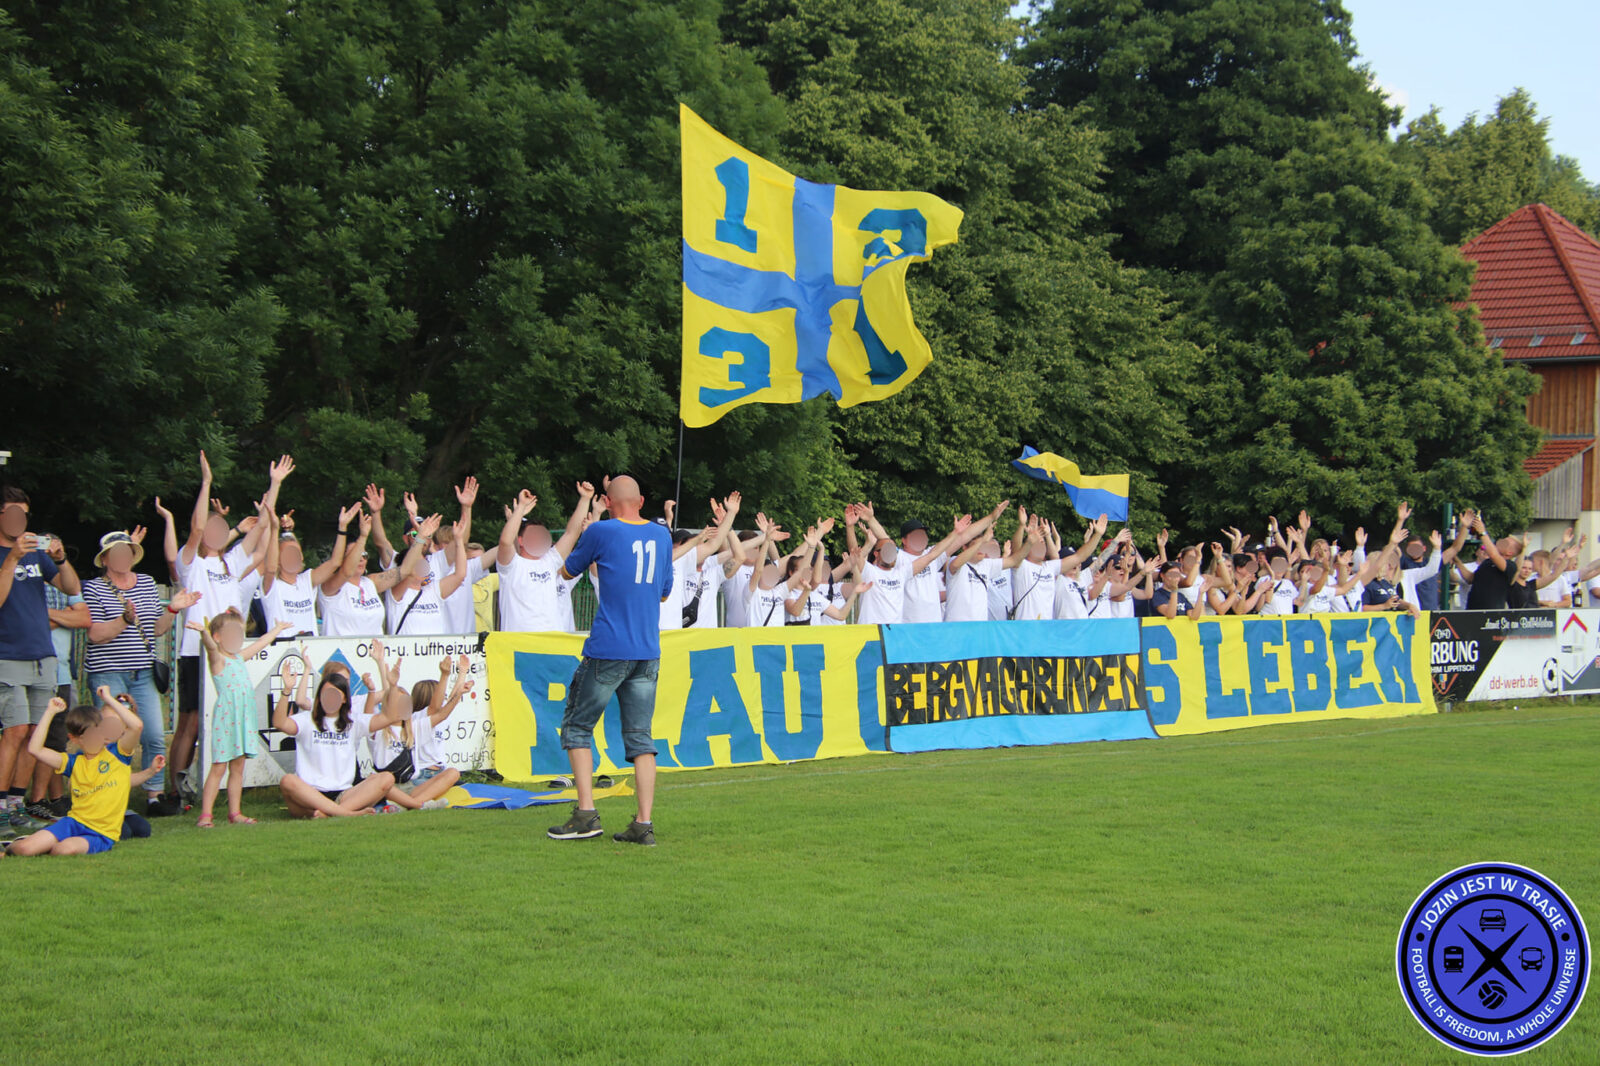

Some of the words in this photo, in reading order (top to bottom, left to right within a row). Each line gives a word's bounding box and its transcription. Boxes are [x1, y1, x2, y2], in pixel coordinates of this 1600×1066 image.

[699, 326, 771, 408] 3
[25, 563, 43, 578] 31
[632, 540, 657, 584] 11
[356, 643, 409, 658] Ofn-u.
[1431, 640, 1479, 665] RBUNG
[1198, 614, 1422, 719] LEBEN
[1431, 665, 1443, 674] HIM
[1489, 675, 1538, 690] dd-werb.de
[456, 720, 477, 741] 57
